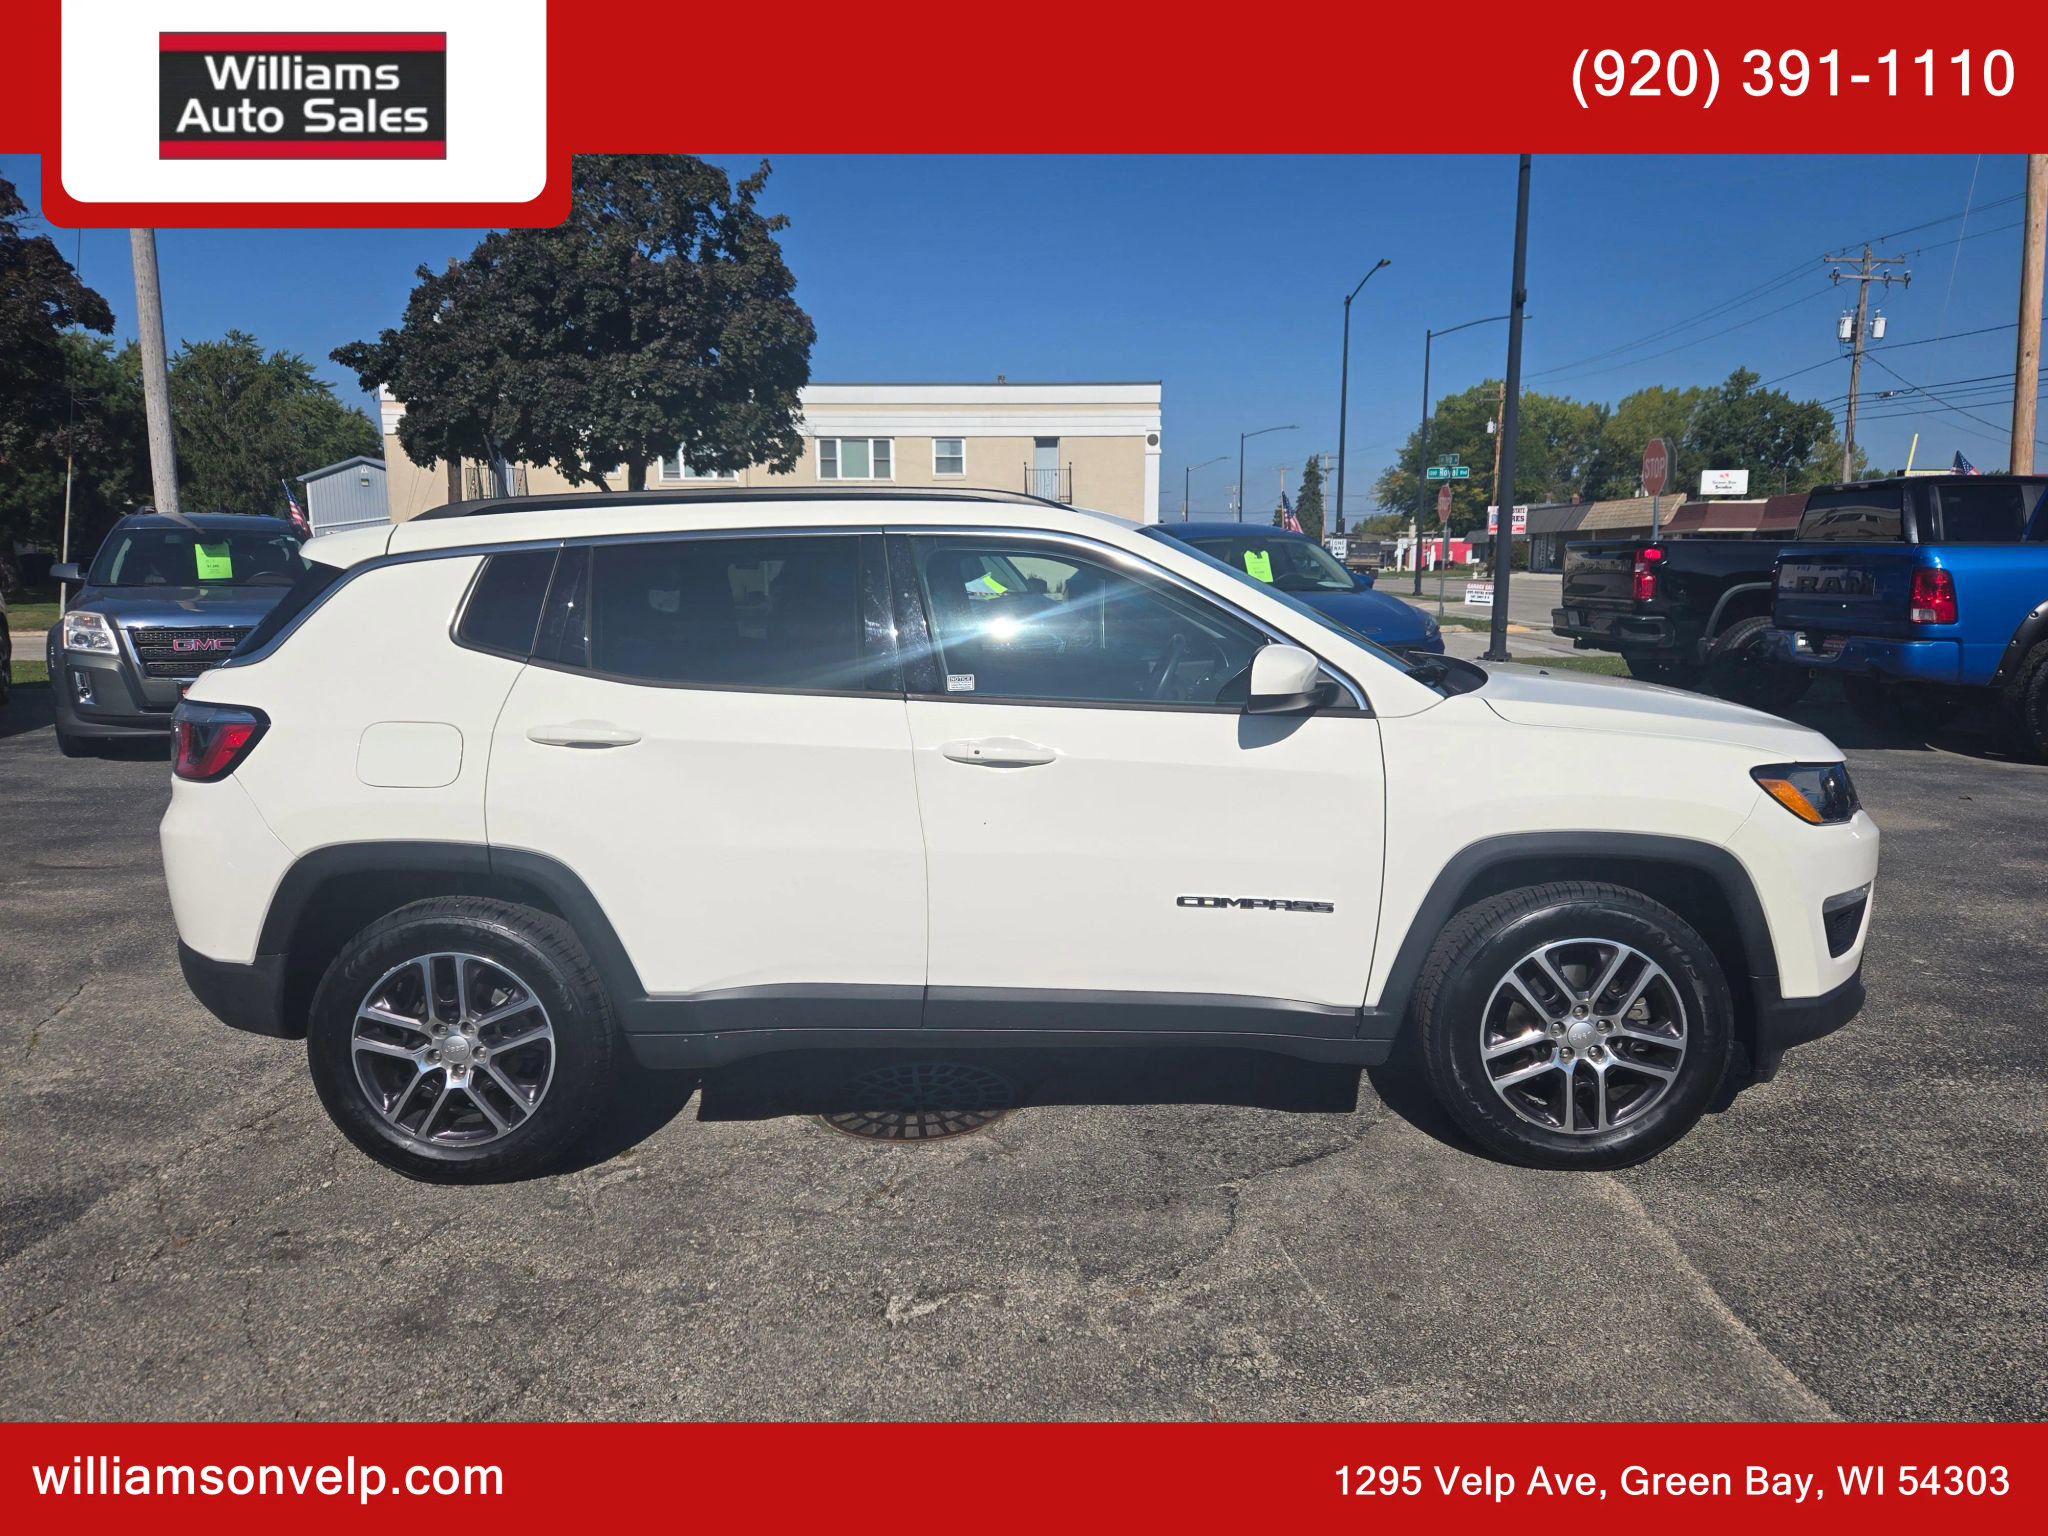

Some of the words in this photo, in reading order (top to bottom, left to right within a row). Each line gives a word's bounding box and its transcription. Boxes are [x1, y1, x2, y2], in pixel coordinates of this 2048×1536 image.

[1644, 457, 1665, 479] STOP
[1797, 576, 1874, 594] RAM
[173, 638, 236, 651] GMC
[1177, 896, 1334, 913] COMPASS
